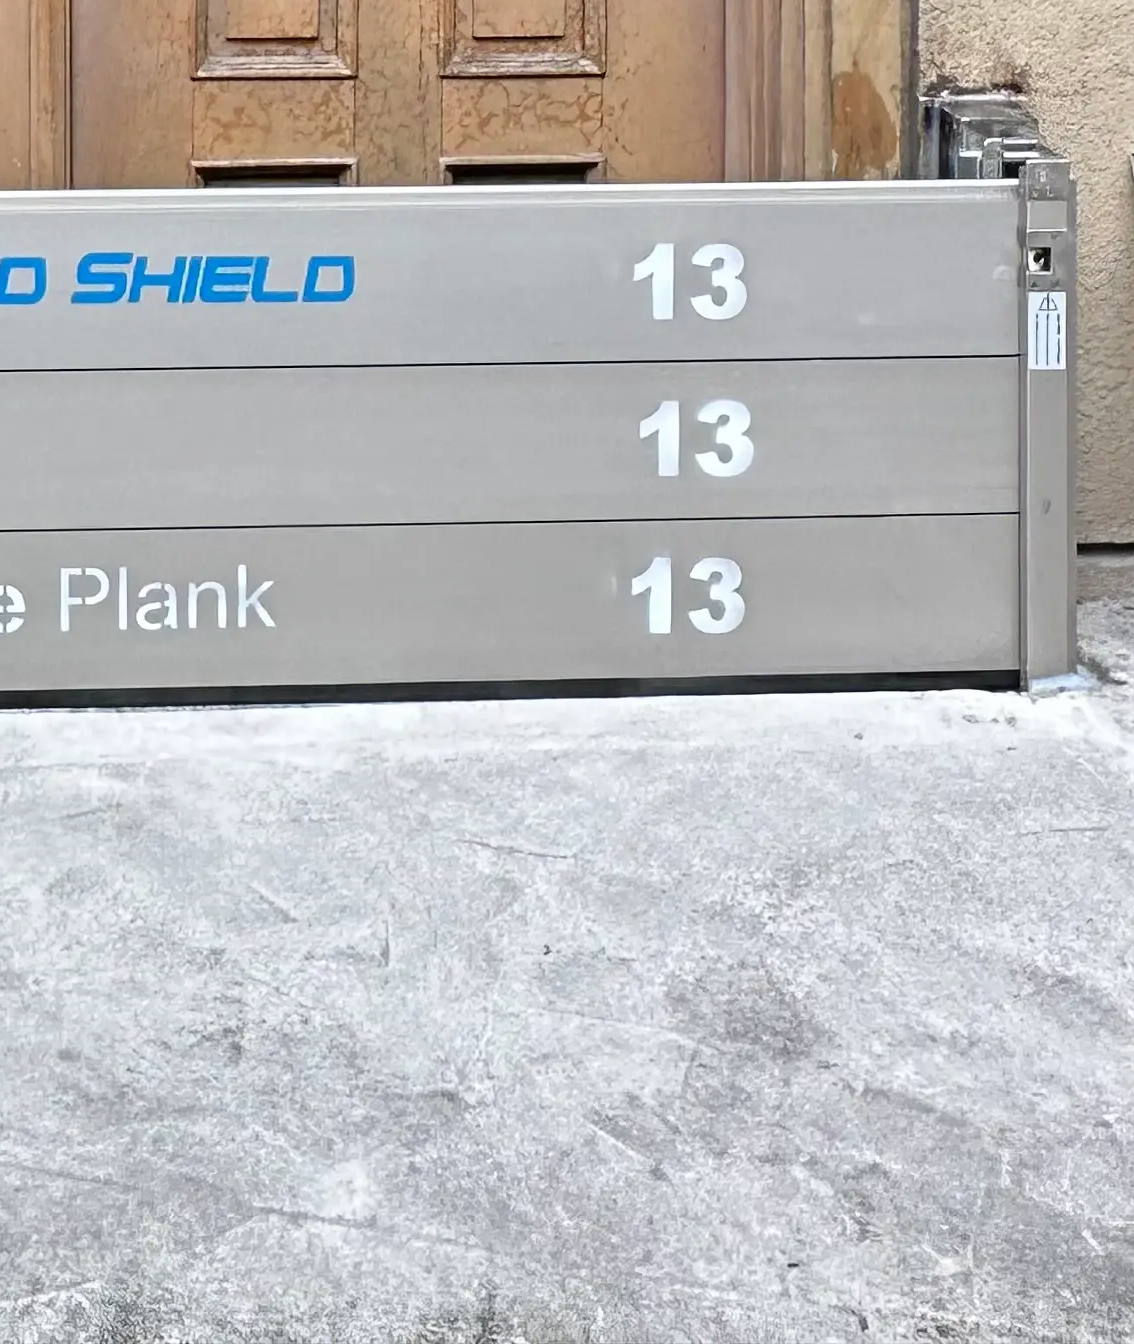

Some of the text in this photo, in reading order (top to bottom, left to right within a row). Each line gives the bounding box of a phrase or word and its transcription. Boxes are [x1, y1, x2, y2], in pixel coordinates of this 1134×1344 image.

[70, 252, 357, 306] SHIELD
[633, 243, 749, 321] 13
[639, 400, 756, 478] 13
[59, 564, 277, 633] Plank
[631, 557, 747, 635] 13
